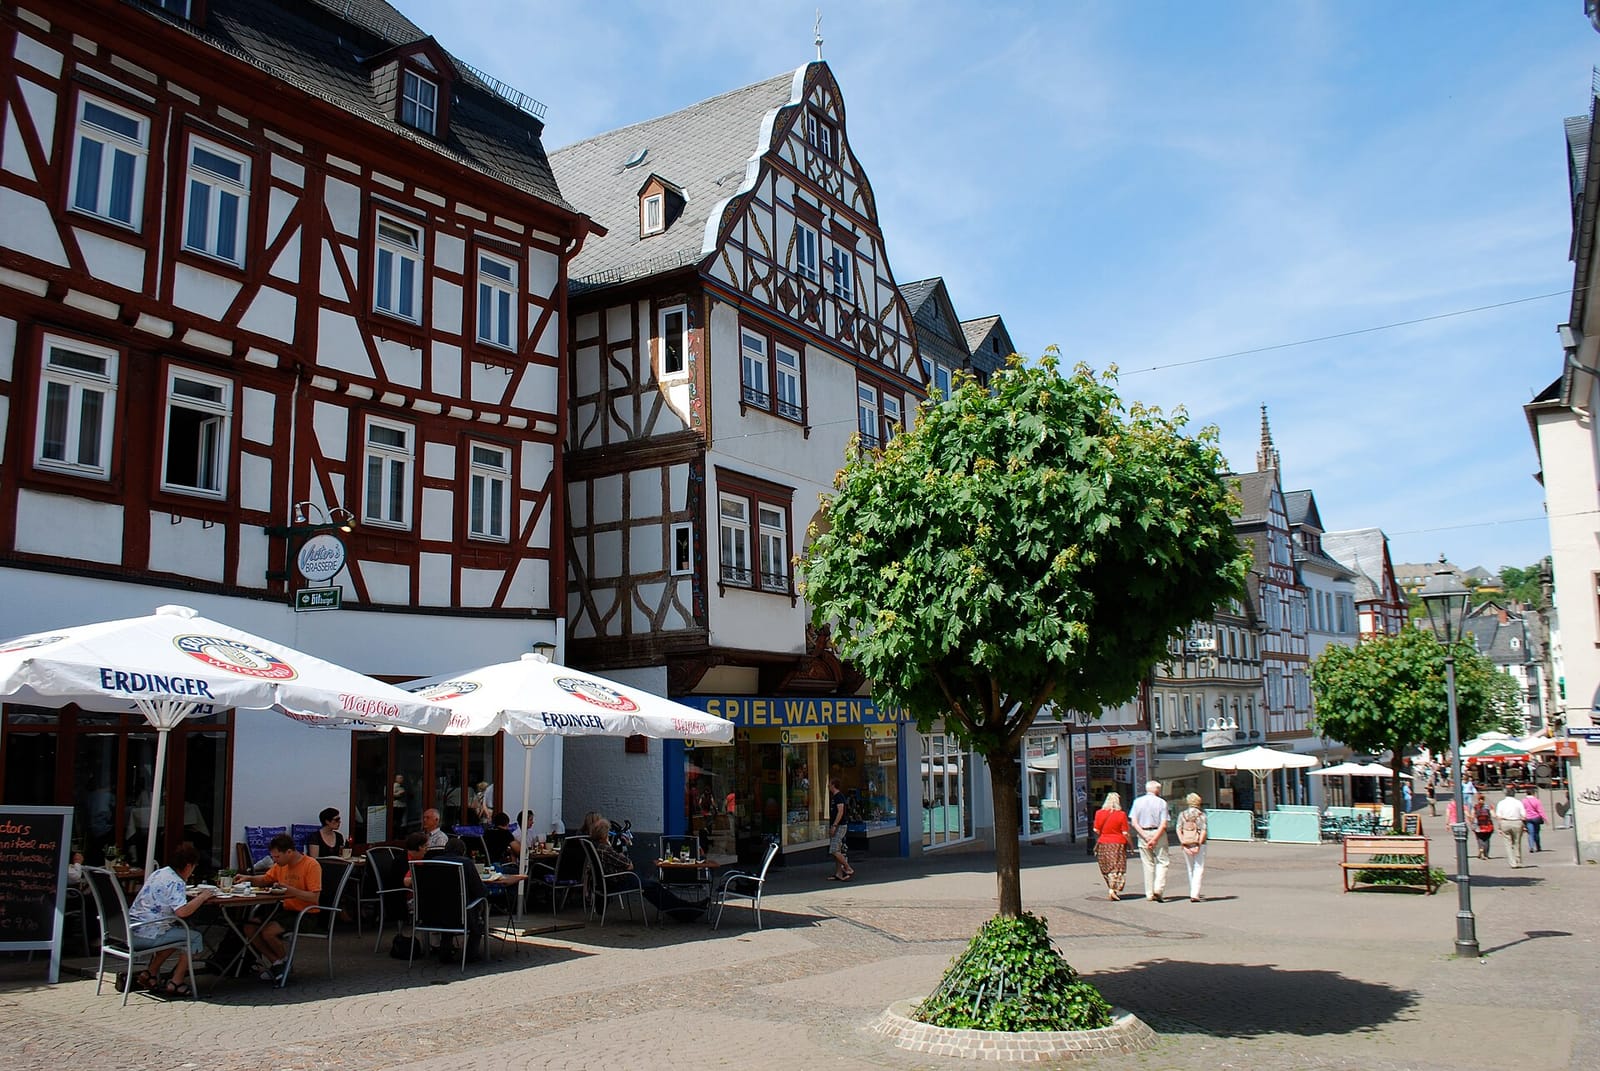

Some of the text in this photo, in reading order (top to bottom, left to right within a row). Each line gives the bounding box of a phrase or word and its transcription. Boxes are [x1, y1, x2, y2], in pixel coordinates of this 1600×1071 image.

[306, 561, 338, 573] BRASSERIE
[181, 636, 273, 661] ERDINGER
[99, 667, 216, 700] ERDINGER
[338, 693, 400, 718] Weißbier
[542, 711, 605, 730] ERDINGER
[1089, 757, 1133, 767] assbilder
[0, 820, 31, 836] ctors
